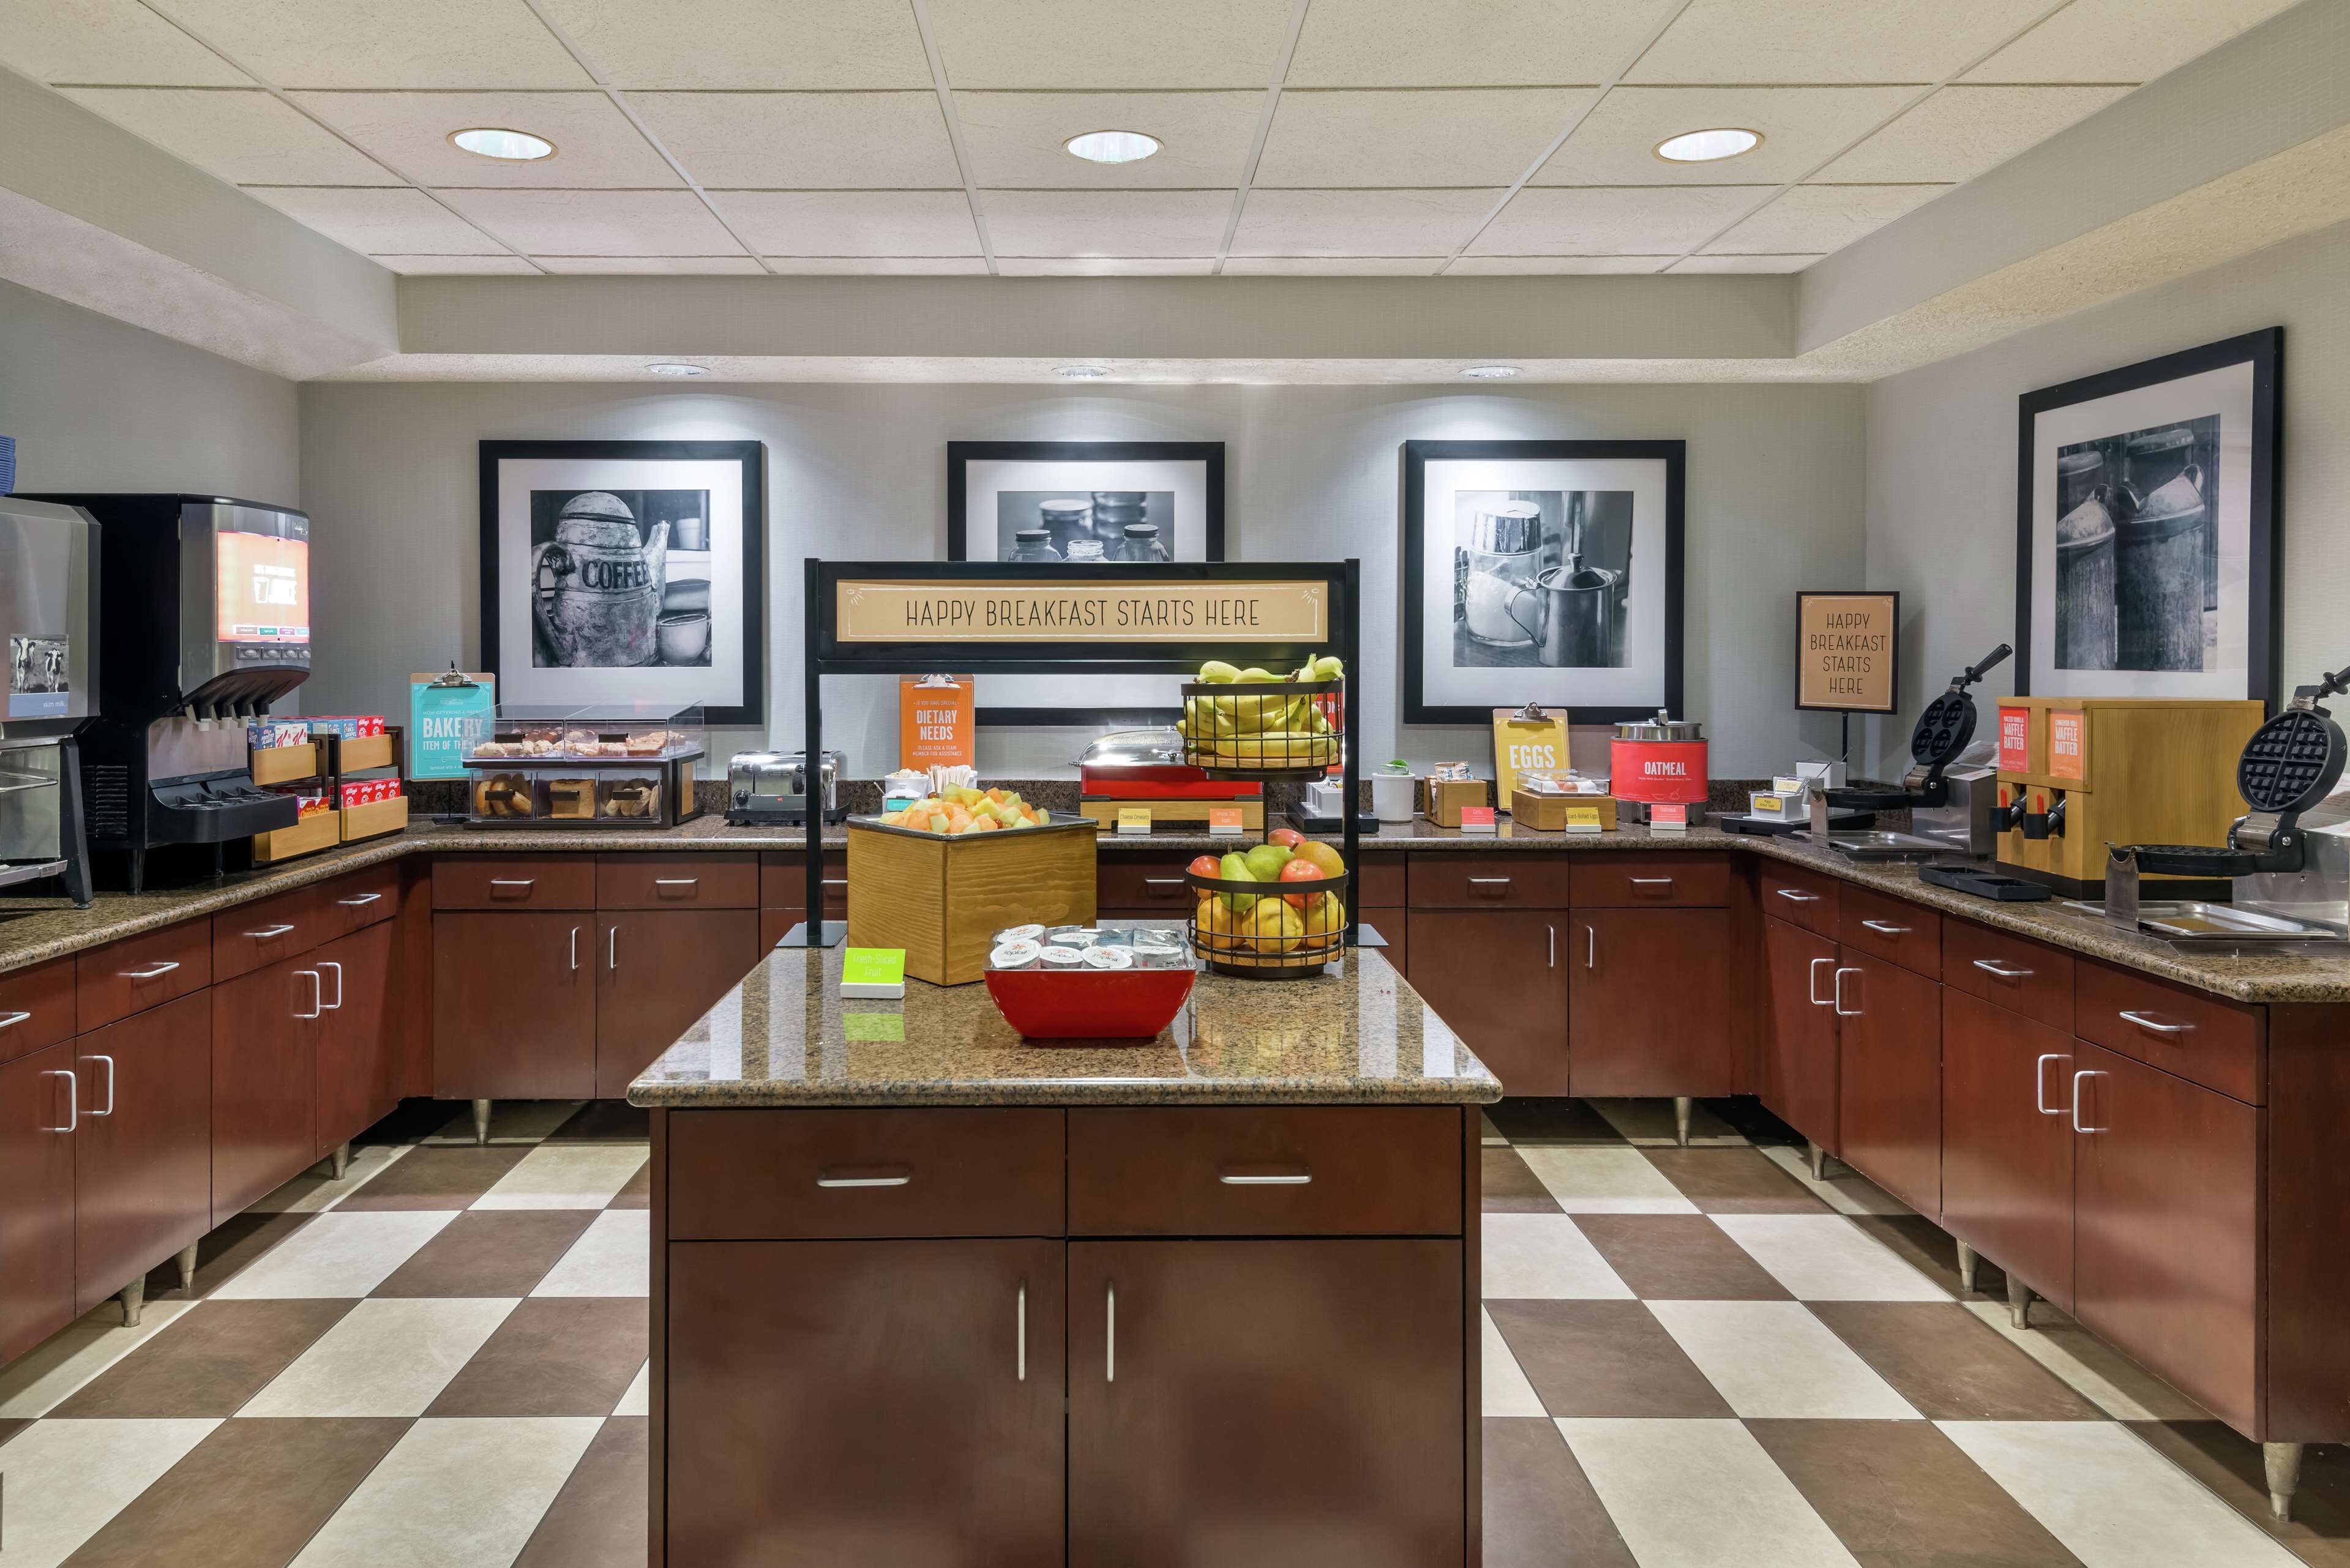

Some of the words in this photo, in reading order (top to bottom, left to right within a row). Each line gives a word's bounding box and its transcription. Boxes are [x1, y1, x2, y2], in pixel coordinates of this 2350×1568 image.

[582, 561, 652, 589] COFFEE
[907, 600, 975, 626] HAPPY
[986, 600, 1107, 626] BREAKFAST
[1117, 600, 1194, 626] STARTS
[1205, 599, 1259, 625] HERE
[1827, 613, 1870, 629] HAPPY
[1810, 634, 1886, 651] BREAKFAST
[1822, 656, 1871, 673] STARTS
[1829, 678, 1864, 695] HERE
[916, 710, 957, 724] DIETARY
[422, 717, 483, 738] BAKERY
[920, 726, 953, 740] NEEDS
[2004, 723, 2024, 737] WAFFLE
[2055, 726, 2078, 742] WAFFLE
[422, 741, 440, 751] ITEM
[443, 741, 451, 750] OF
[2004, 736, 2024, 750] BATTER
[2055, 741, 2078, 756] BATTER
[1509, 745, 1556, 769] EGGS
[1644, 761, 1686, 775] OATMEAL
[864, 967, 882, 977] Fruit
